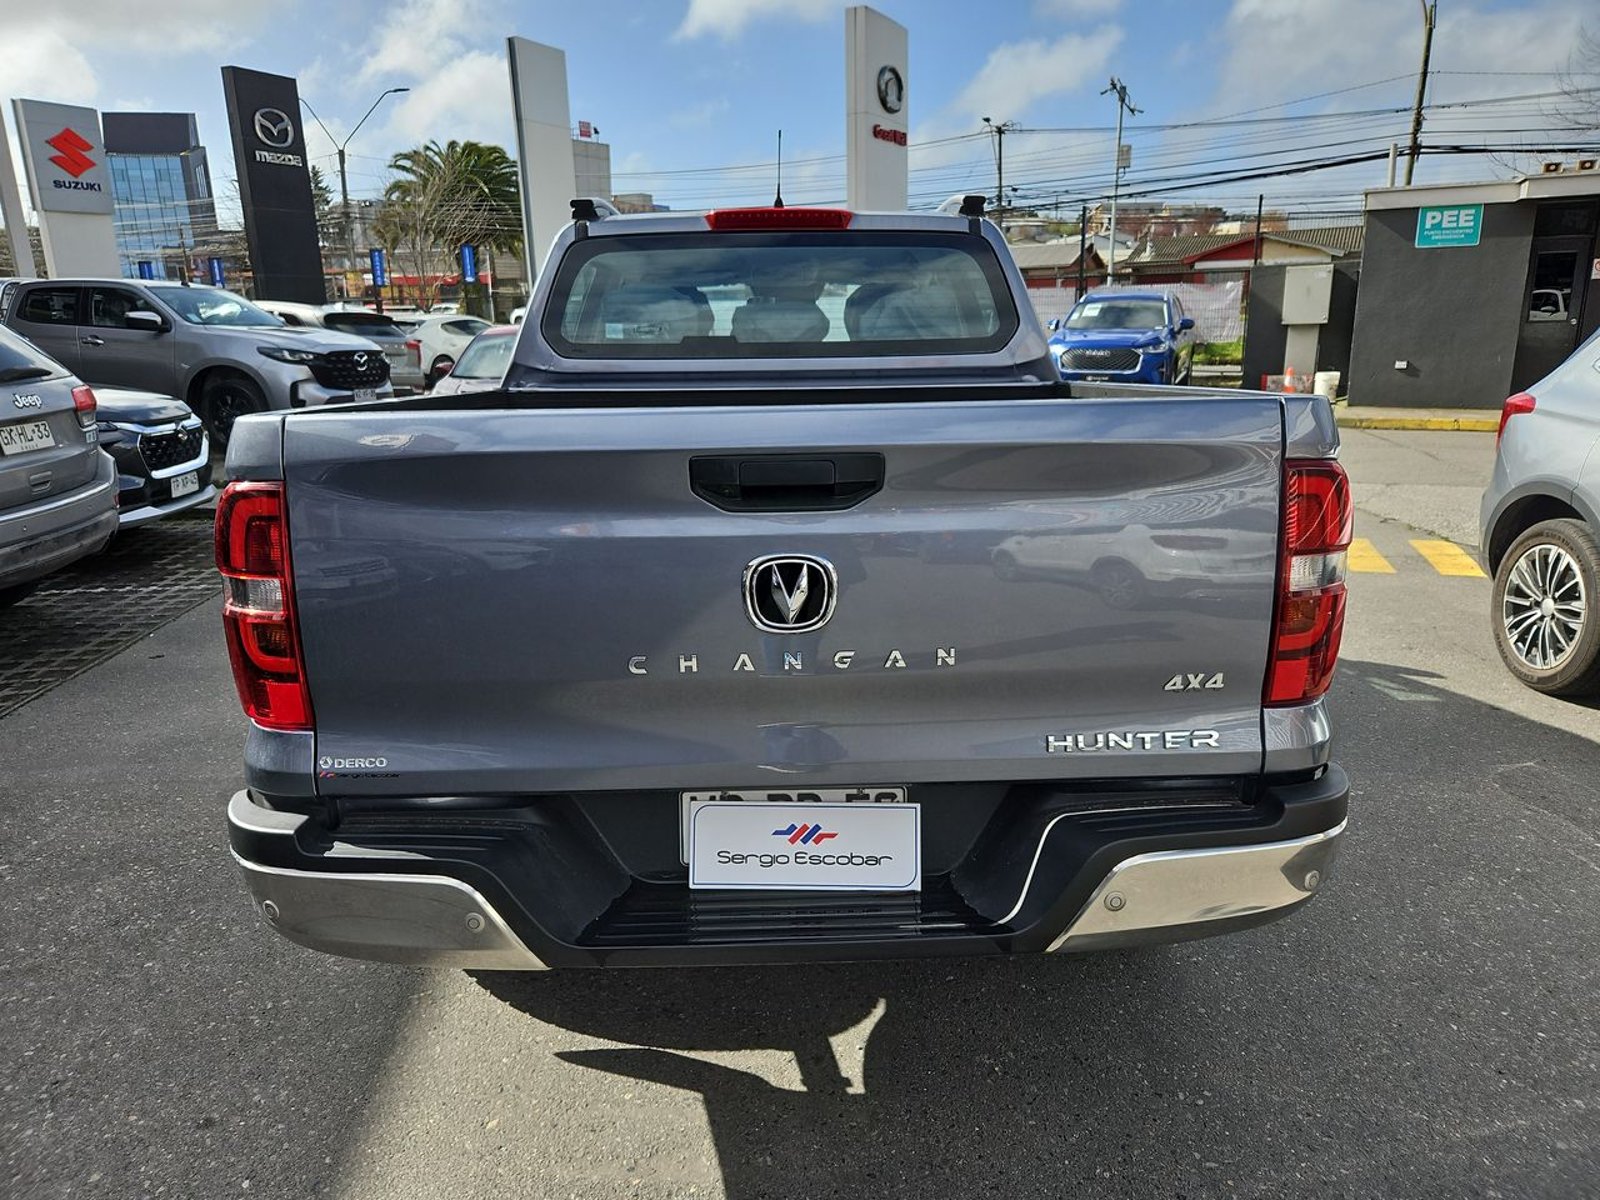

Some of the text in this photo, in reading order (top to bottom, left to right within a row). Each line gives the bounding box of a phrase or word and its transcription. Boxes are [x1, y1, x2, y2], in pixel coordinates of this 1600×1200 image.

[255, 150, 303, 167] mazda
[53, 179, 102, 192] SUZUKI
[1425, 209, 1476, 229] PEE
[14, 394, 42, 409] Jeep
[628, 648, 960, 675] CHANGAN
[1164, 672, 1225, 693] 4X4
[1047, 729, 1221, 753] HUNTER
[334, 757, 388, 769] DERCO
[717, 850, 893, 868] Sergio Escobar
